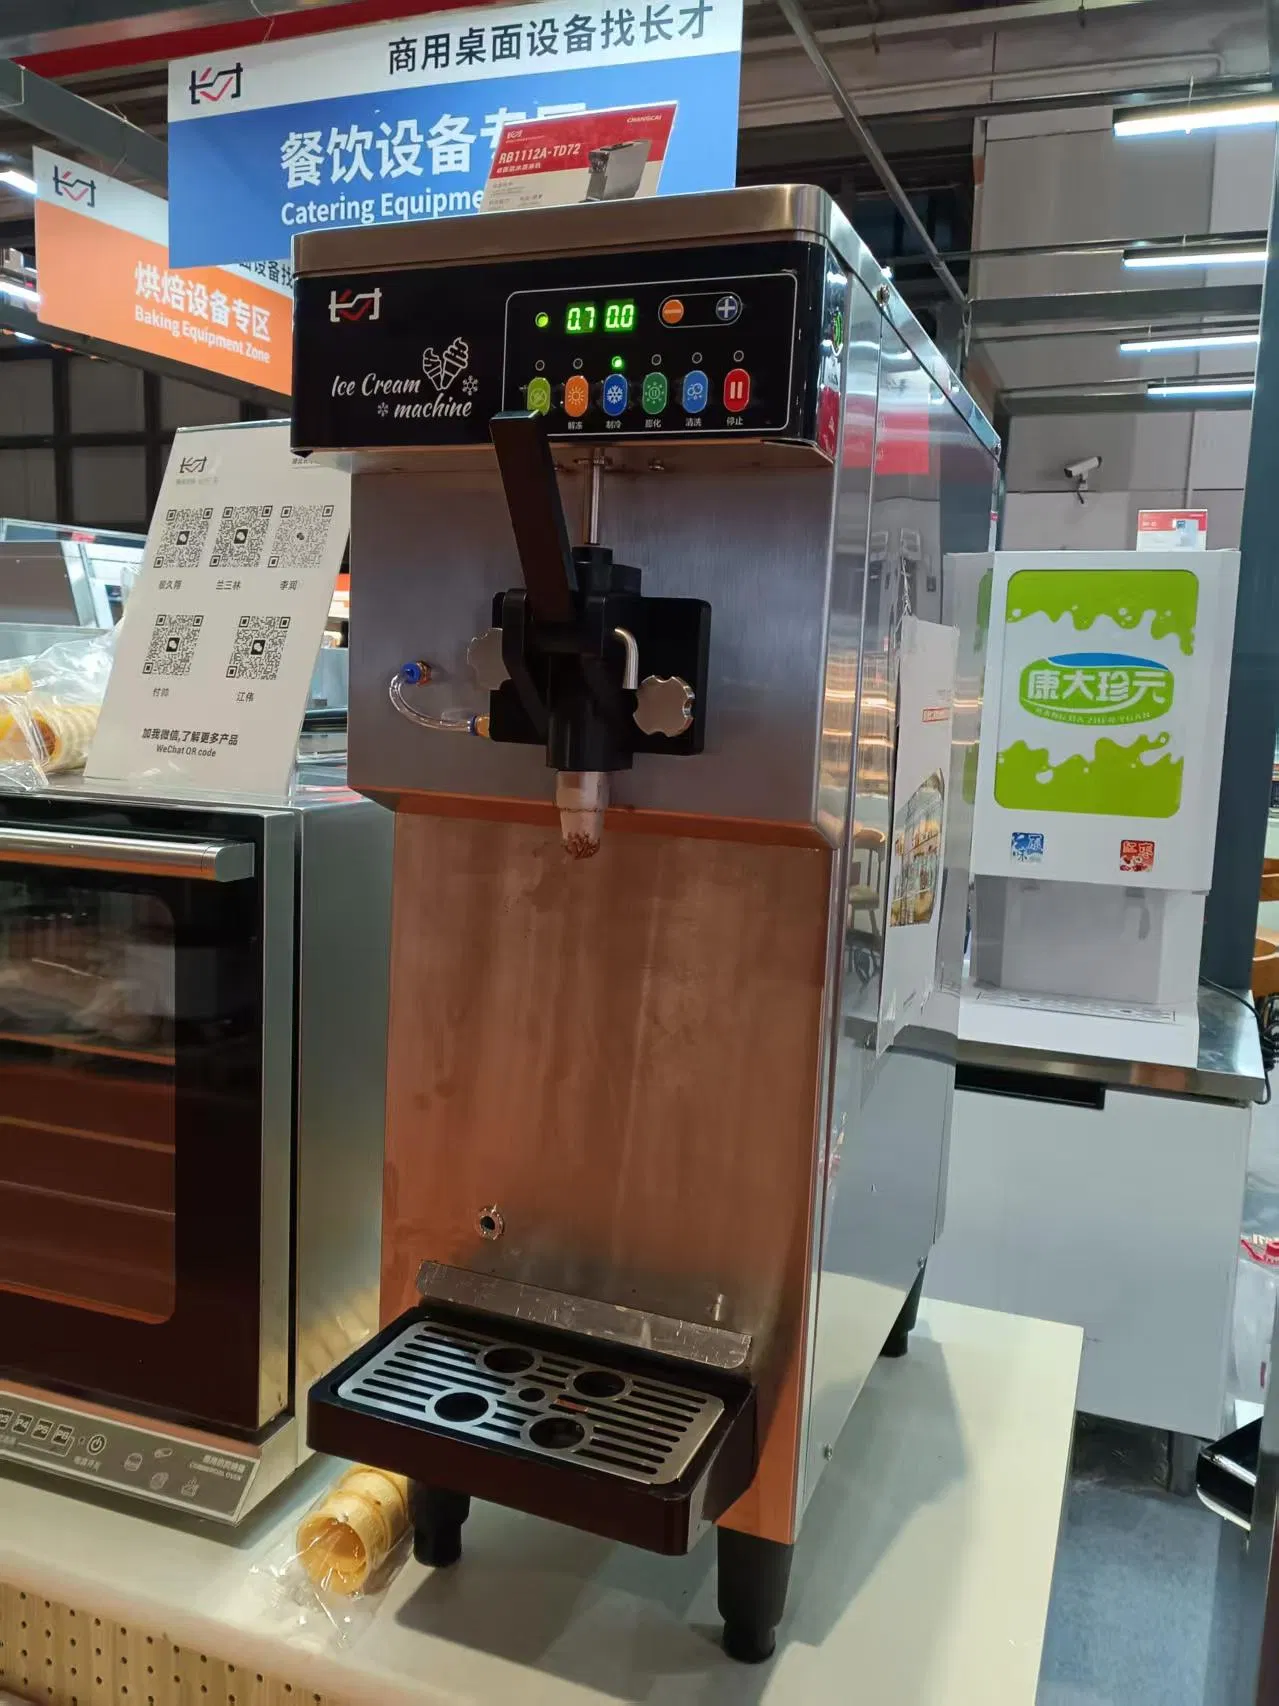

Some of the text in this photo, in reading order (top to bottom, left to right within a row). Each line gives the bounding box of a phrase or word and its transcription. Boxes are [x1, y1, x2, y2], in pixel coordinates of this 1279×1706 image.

[388, 2, 713, 75] 商用桌面设备找长才
[280, 103, 586, 189] 餐饮设备
[281, 192, 375, 225] Catering
[381, 187, 484, 220] Equipme
[134, 260, 271, 342] 烘焙设备专区
[135, 304, 271, 363] Baking Equipment Zone
[331, 373, 421, 397] Ice Cream
[394, 393, 472, 419] machine
[726, 417, 744, 426] 停止
[1027, 669, 1167, 704] 康大珍元
[156, 744, 217, 757] WeChat QR code
